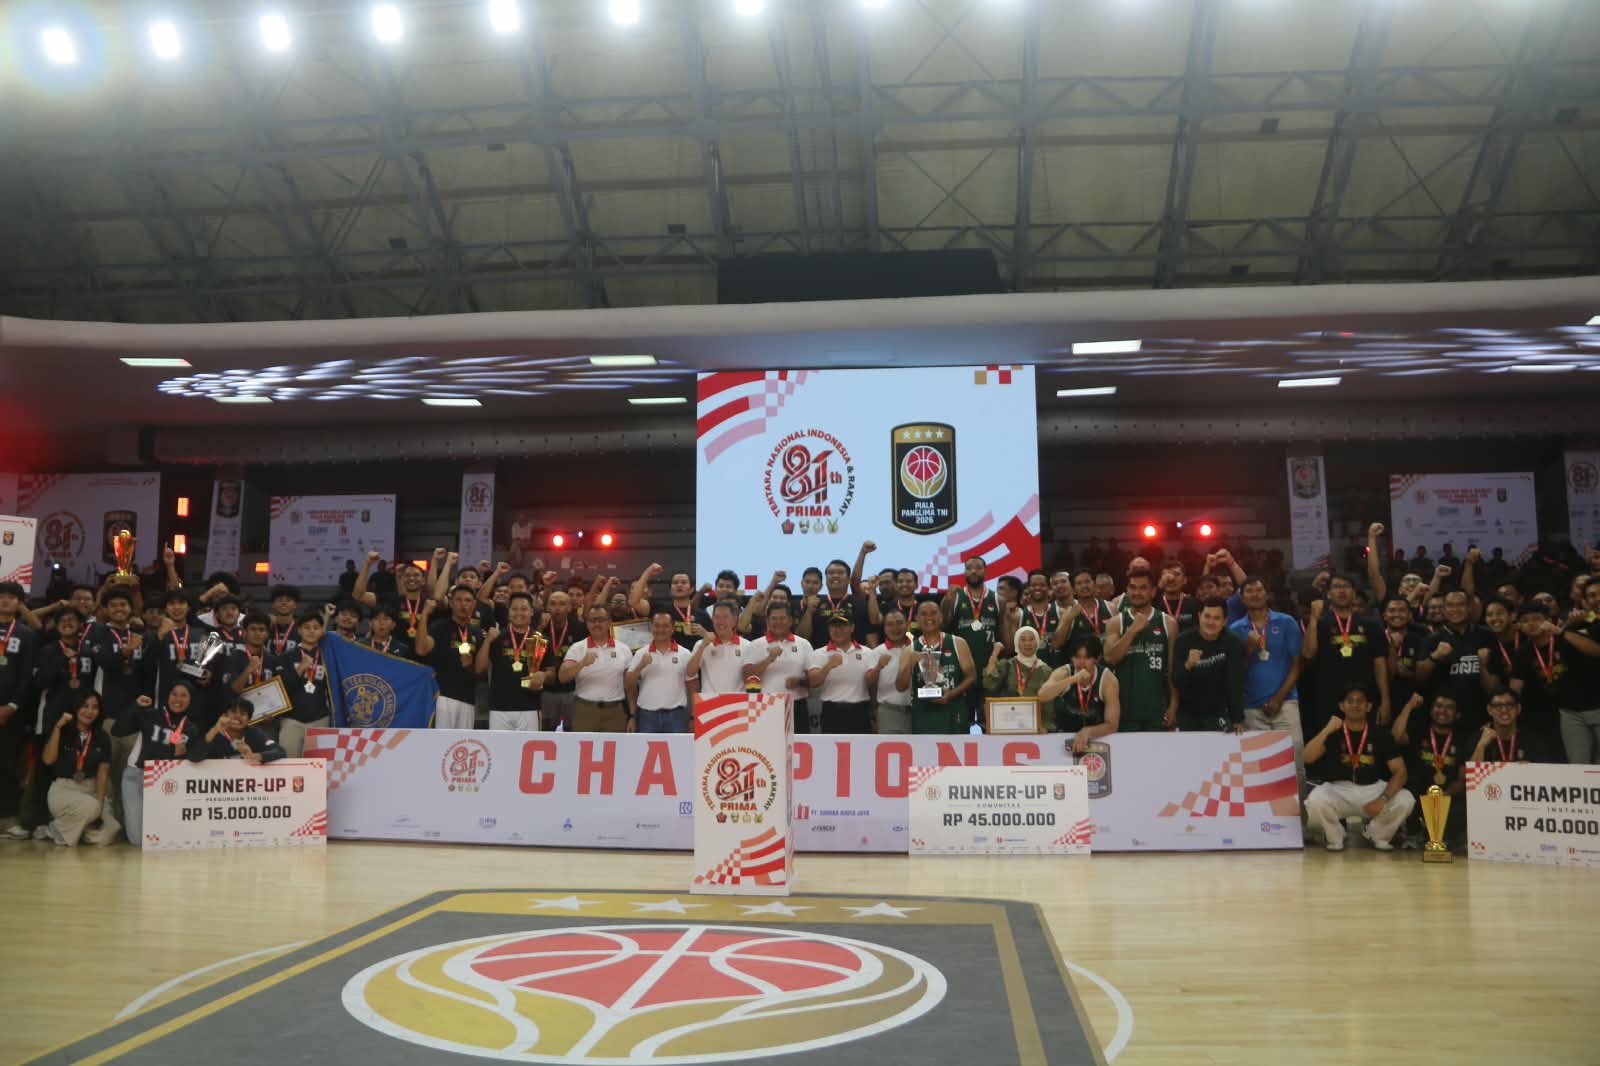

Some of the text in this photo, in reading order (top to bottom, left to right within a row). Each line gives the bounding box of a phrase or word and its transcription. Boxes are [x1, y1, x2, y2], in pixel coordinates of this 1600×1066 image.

[767, 429, 806, 468] NASIONAL
[807, 428, 851, 464] INDONESIA
[764, 469, 781, 518] TENTARA
[839, 475, 855, 517] RAKYAT
[786, 505, 831, 517] PRIMA
[901, 508, 948, 517] PANGLIMA TNI
[914, 501, 934, 509] PIALA
[1149, 656, 1163, 670] 33
[186, 777, 286, 794] RUNNER-UP
[948, 784, 1047, 800] RUNNER-UP
[182, 805, 291, 821] RP 15.000.000
[720, 802, 758, 811] PRIMA
[1547, 807, 1595, 815] INSTANSI
[943, 812, 1056, 827] RP 45.000.000
[1505, 815, 1528, 831] RP
